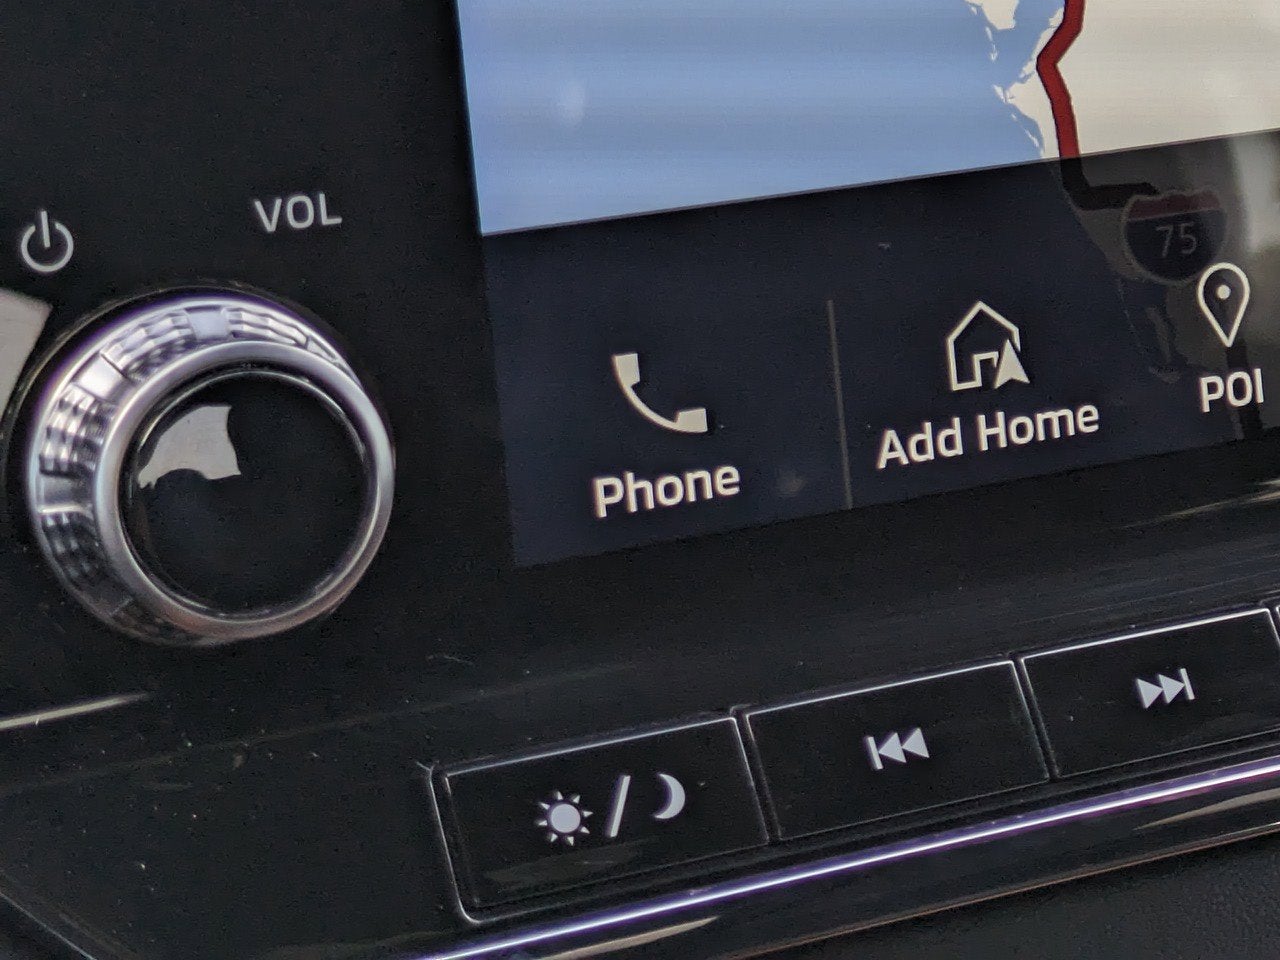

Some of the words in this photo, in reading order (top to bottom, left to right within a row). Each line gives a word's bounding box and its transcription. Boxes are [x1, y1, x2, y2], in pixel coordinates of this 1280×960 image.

[254, 194, 342, 233] VOL
[1155, 223, 1197, 257] 75
[1200, 368, 1264, 413] POI
[876, 416, 964, 469] Add
[977, 403, 1099, 451] Home
[594, 461, 741, 518] Phone
